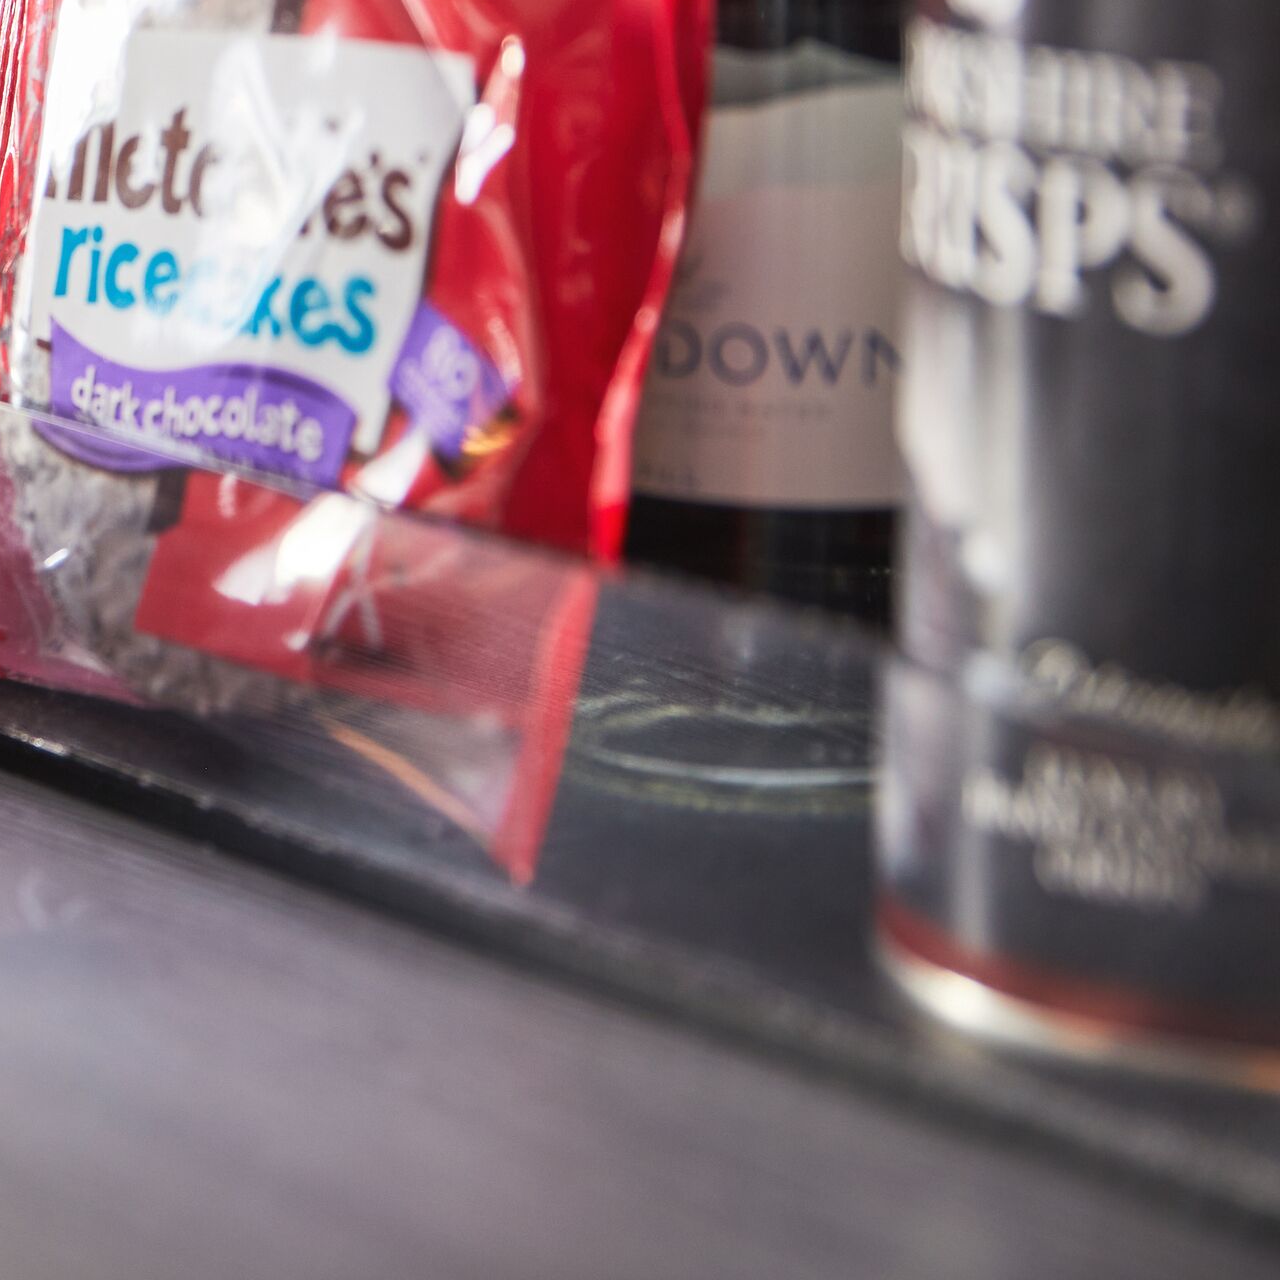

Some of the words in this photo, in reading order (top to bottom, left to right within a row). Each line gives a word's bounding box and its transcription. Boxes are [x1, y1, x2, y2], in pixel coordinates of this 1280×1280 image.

[44, 106, 414, 252] metce's
[53, 225, 180, 317] rice
[70, 364, 143, 429] dark
[143, 384, 324, 464] chocolate
